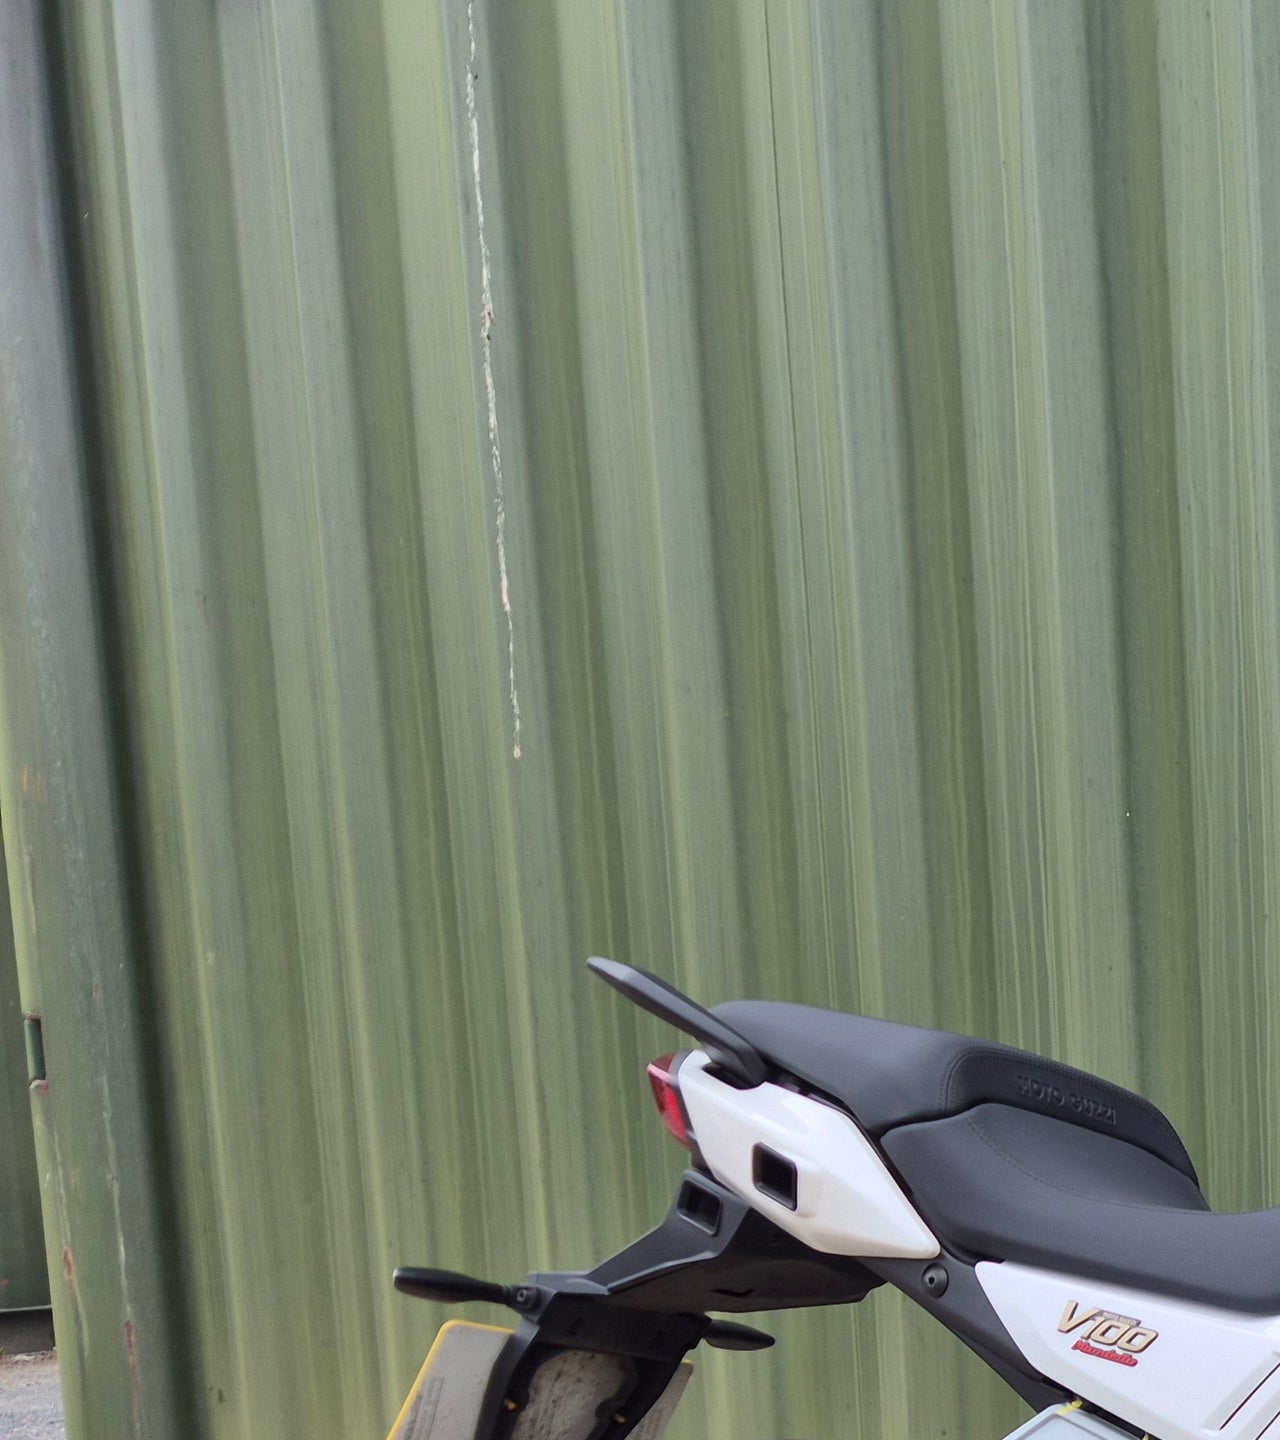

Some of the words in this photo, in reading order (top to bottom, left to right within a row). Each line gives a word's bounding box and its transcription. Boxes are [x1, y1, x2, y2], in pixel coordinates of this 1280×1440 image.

[1018, 1075, 1065, 1106] MOTO
[1068, 1093, 1117, 1125] GUZZI
[1057, 1299, 1159, 1354] V100
